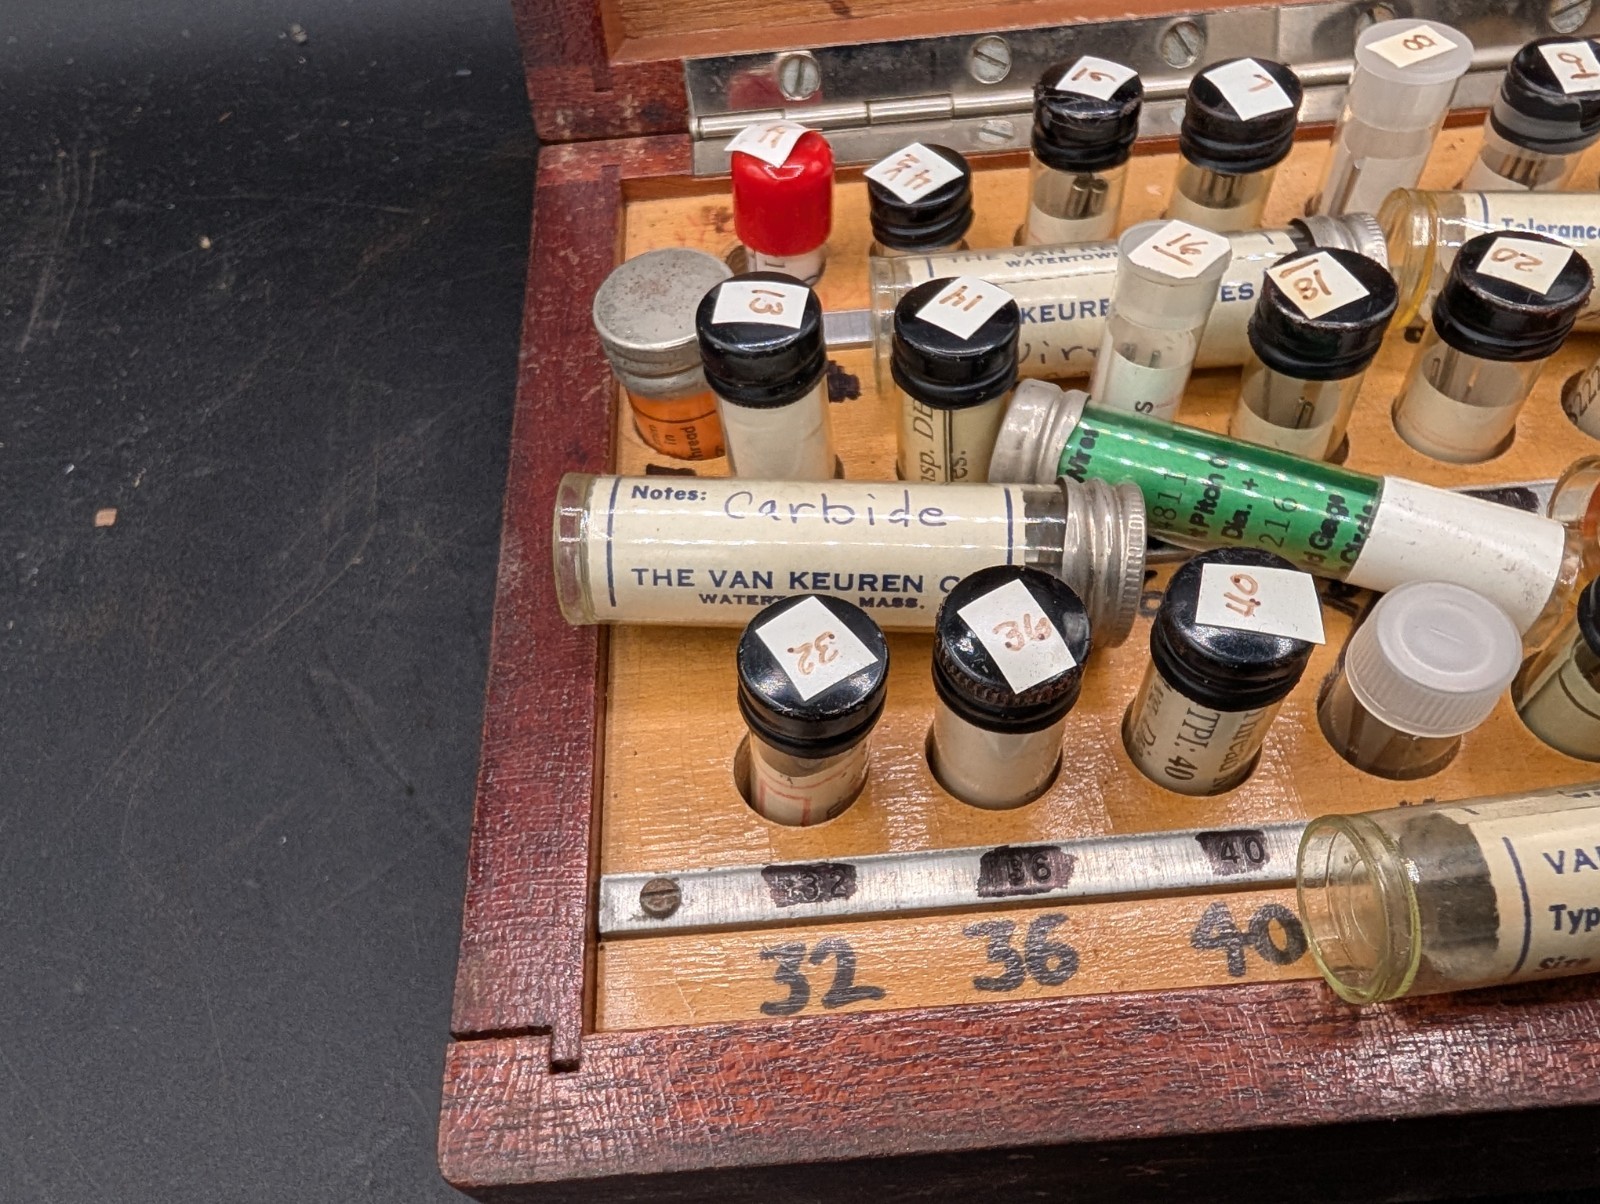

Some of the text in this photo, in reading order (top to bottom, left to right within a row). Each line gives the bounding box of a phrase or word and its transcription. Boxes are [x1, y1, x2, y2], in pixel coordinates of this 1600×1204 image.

[1402, 34, 1436, 51] 8
[1490, 247, 1543, 273] 20
[747, 287, 786, 318] 13
[938, 283, 984, 314] 14
[631, 484, 949, 530] Notes: Carbide
[631, 567, 696, 588] THE
[708, 569, 775, 590] VAN
[788, 570, 924, 594] KEUREN
[991, 611, 1054, 652] 36
[786, 630, 839, 678] 32
[1164, 706, 1222, 781] TPI: 40
[1221, 836, 1265, 864] 40
[963, 912, 1080, 993] 36
[1190, 901, 1308, 978] 40
[760, 938, 887, 1017] 32
